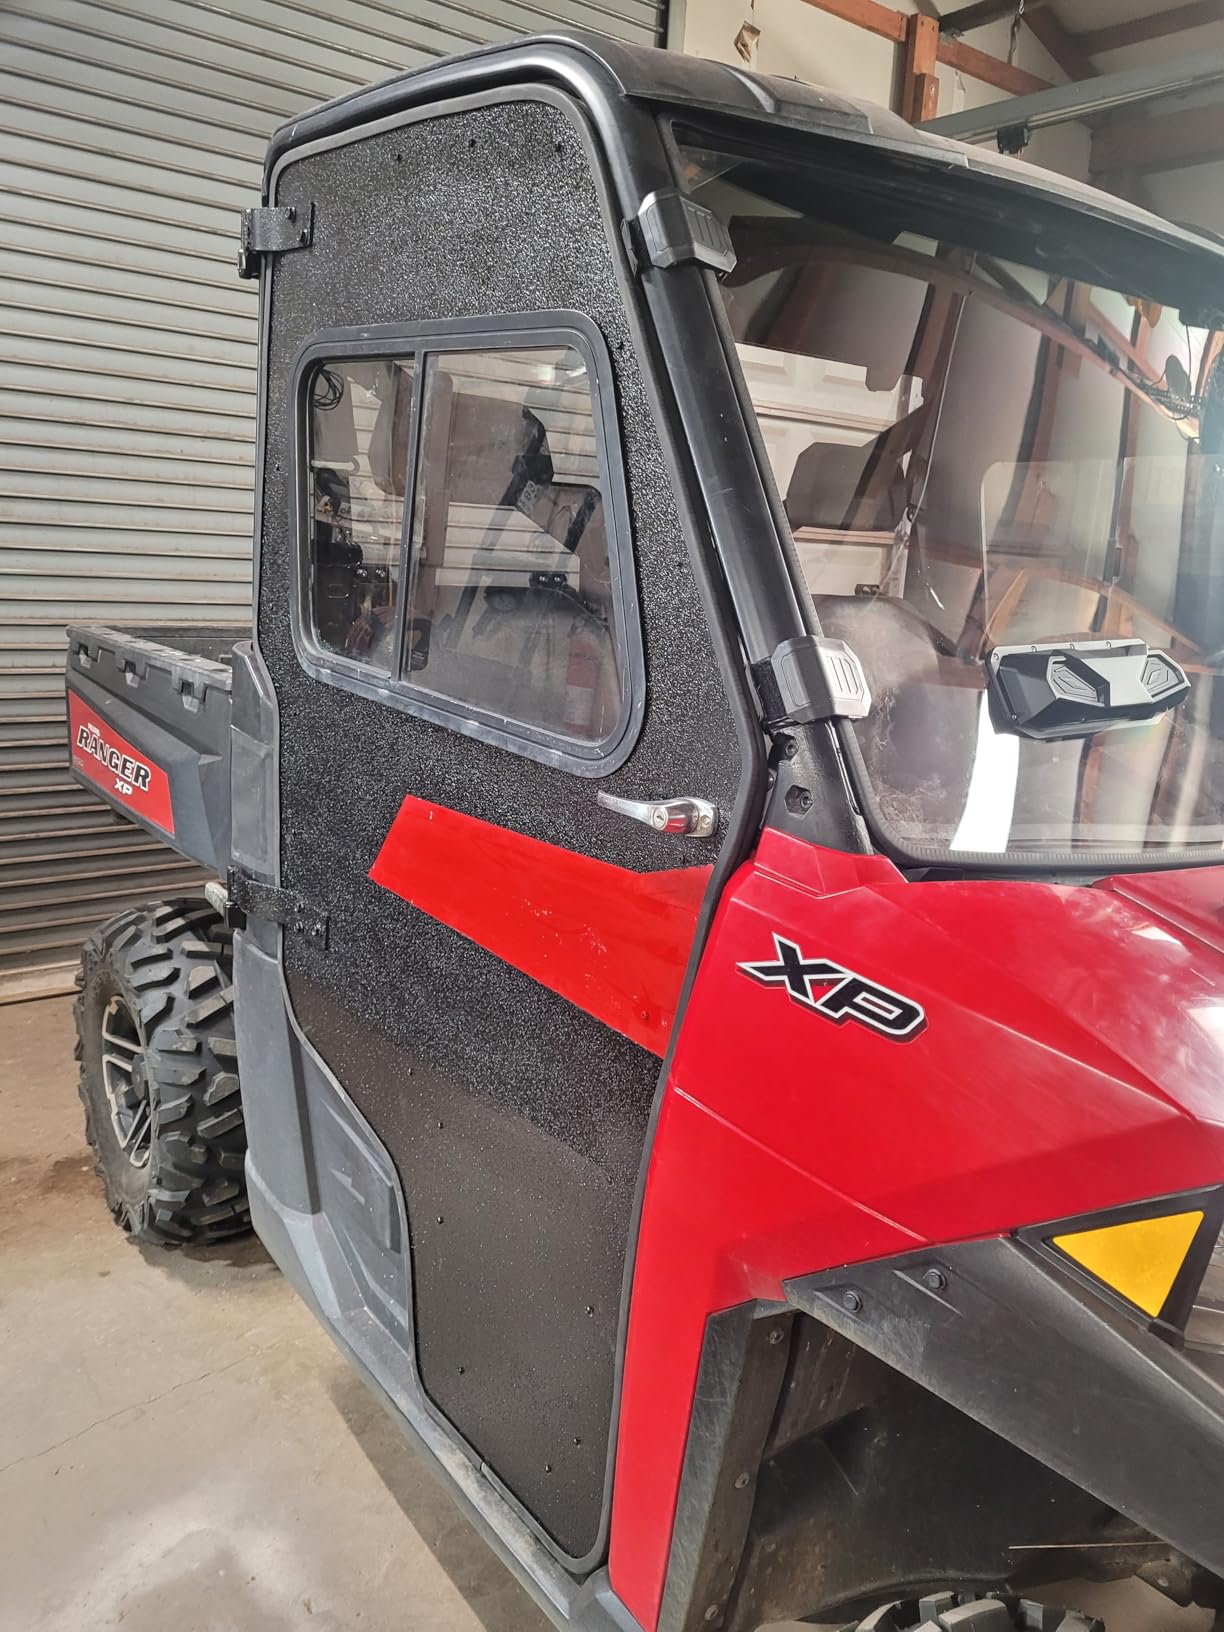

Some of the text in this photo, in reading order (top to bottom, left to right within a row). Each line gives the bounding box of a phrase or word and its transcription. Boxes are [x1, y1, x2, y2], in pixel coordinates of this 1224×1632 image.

[77, 725, 151, 792] RANGER
[114, 778, 133, 795] XP
[735, 931, 927, 1041] XP
